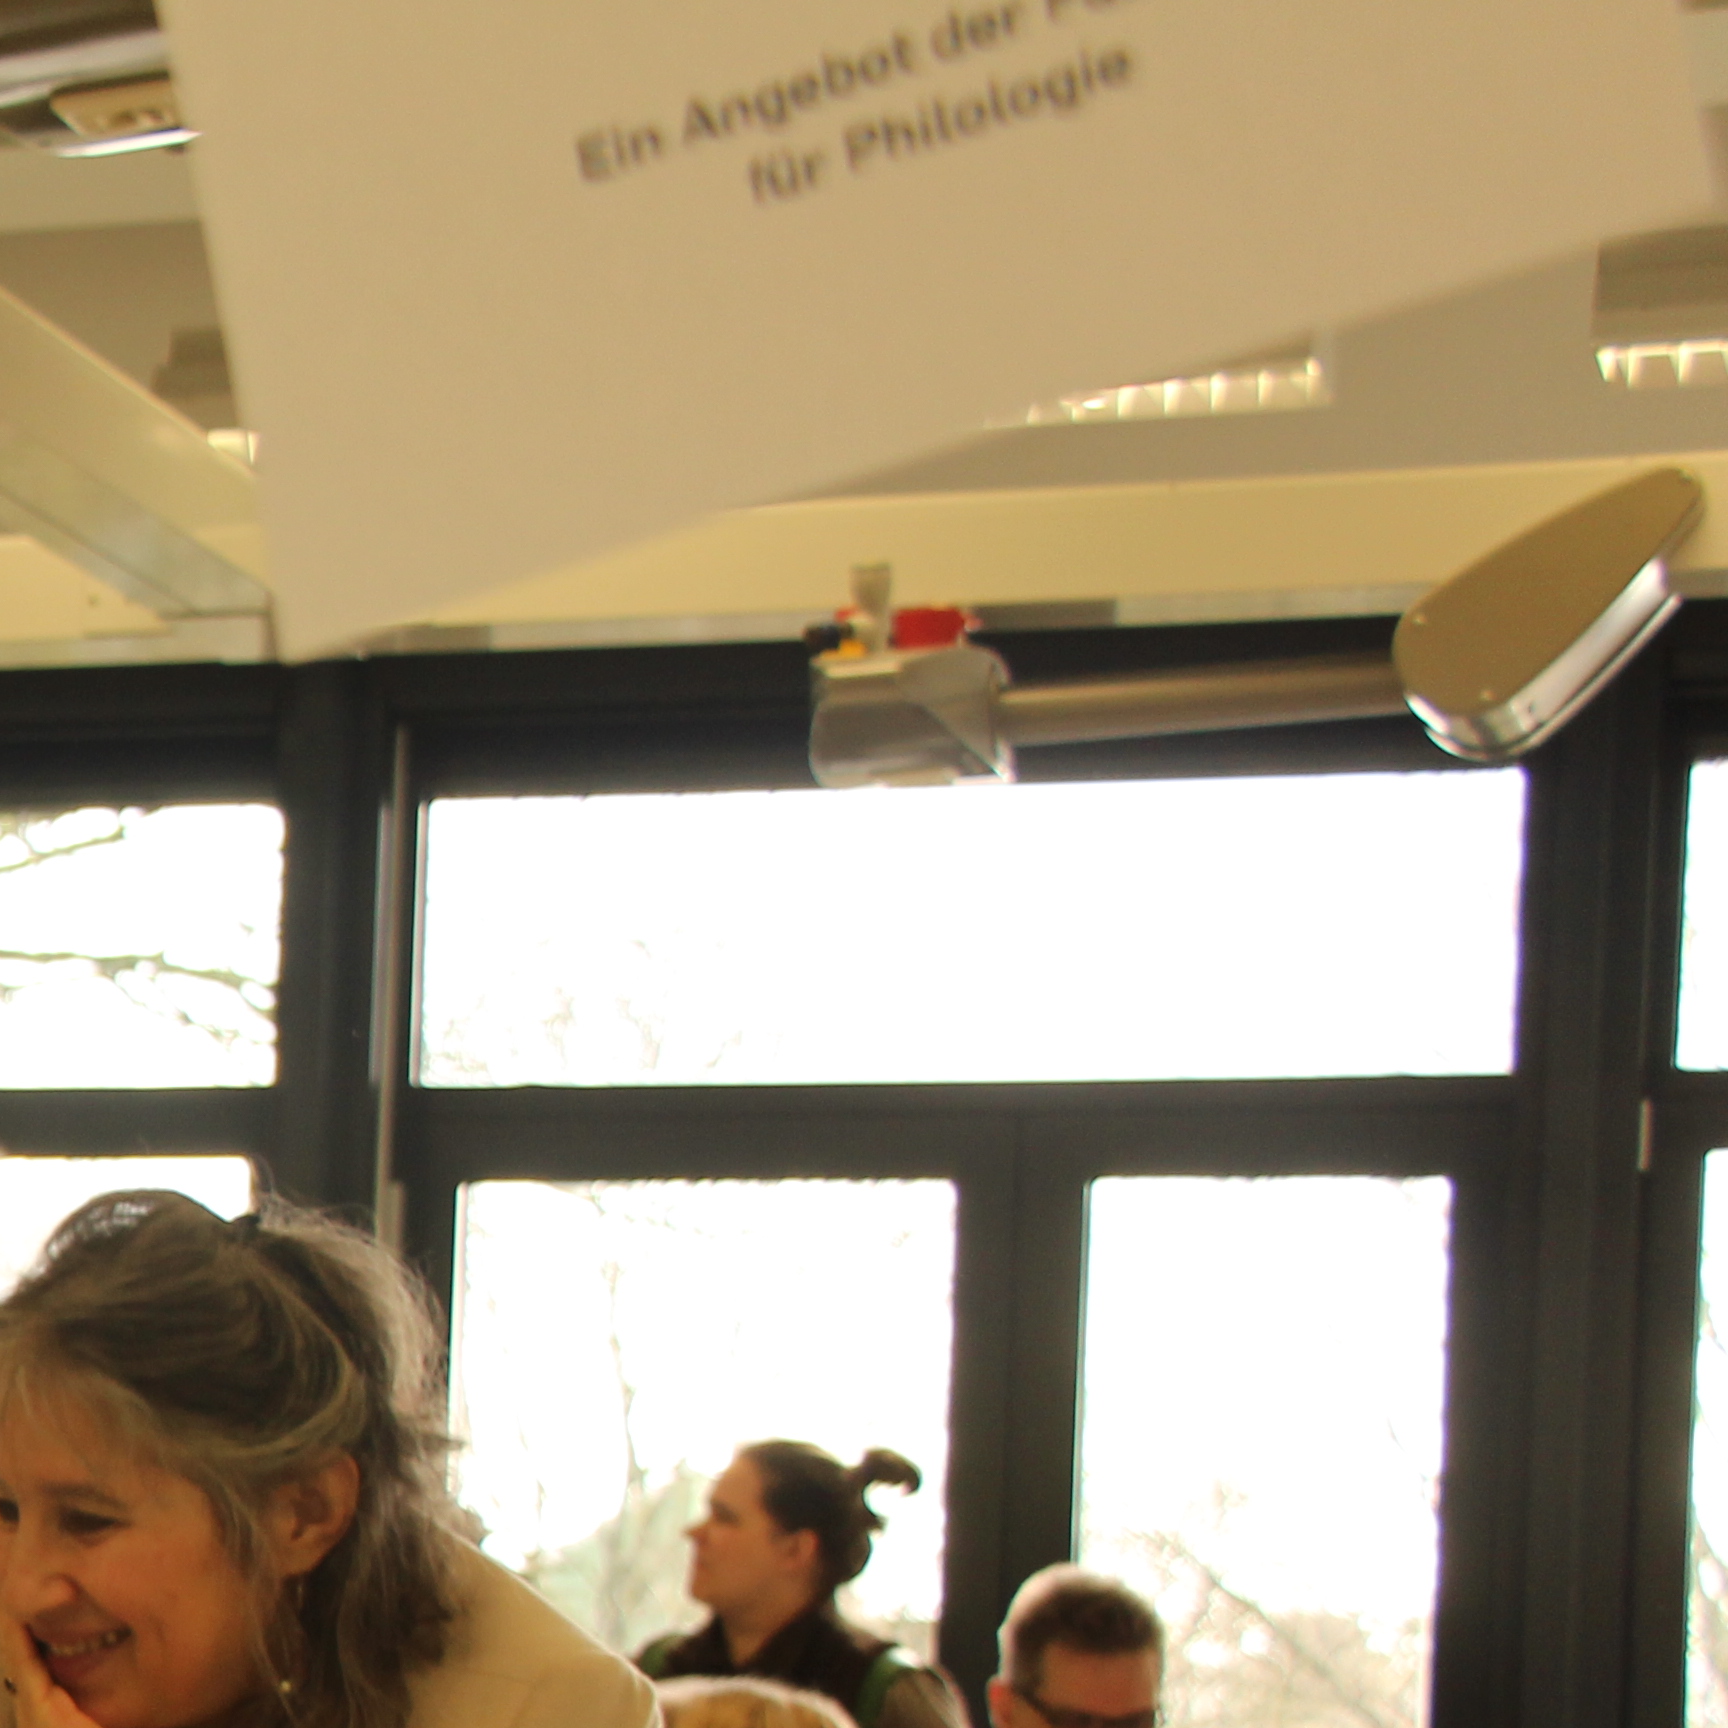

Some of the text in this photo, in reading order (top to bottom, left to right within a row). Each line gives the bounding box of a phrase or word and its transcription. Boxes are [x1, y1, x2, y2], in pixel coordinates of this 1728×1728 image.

[574, 4, 1022, 184] Ein Angebot der
[747, 43, 1134, 204] für Philologie
